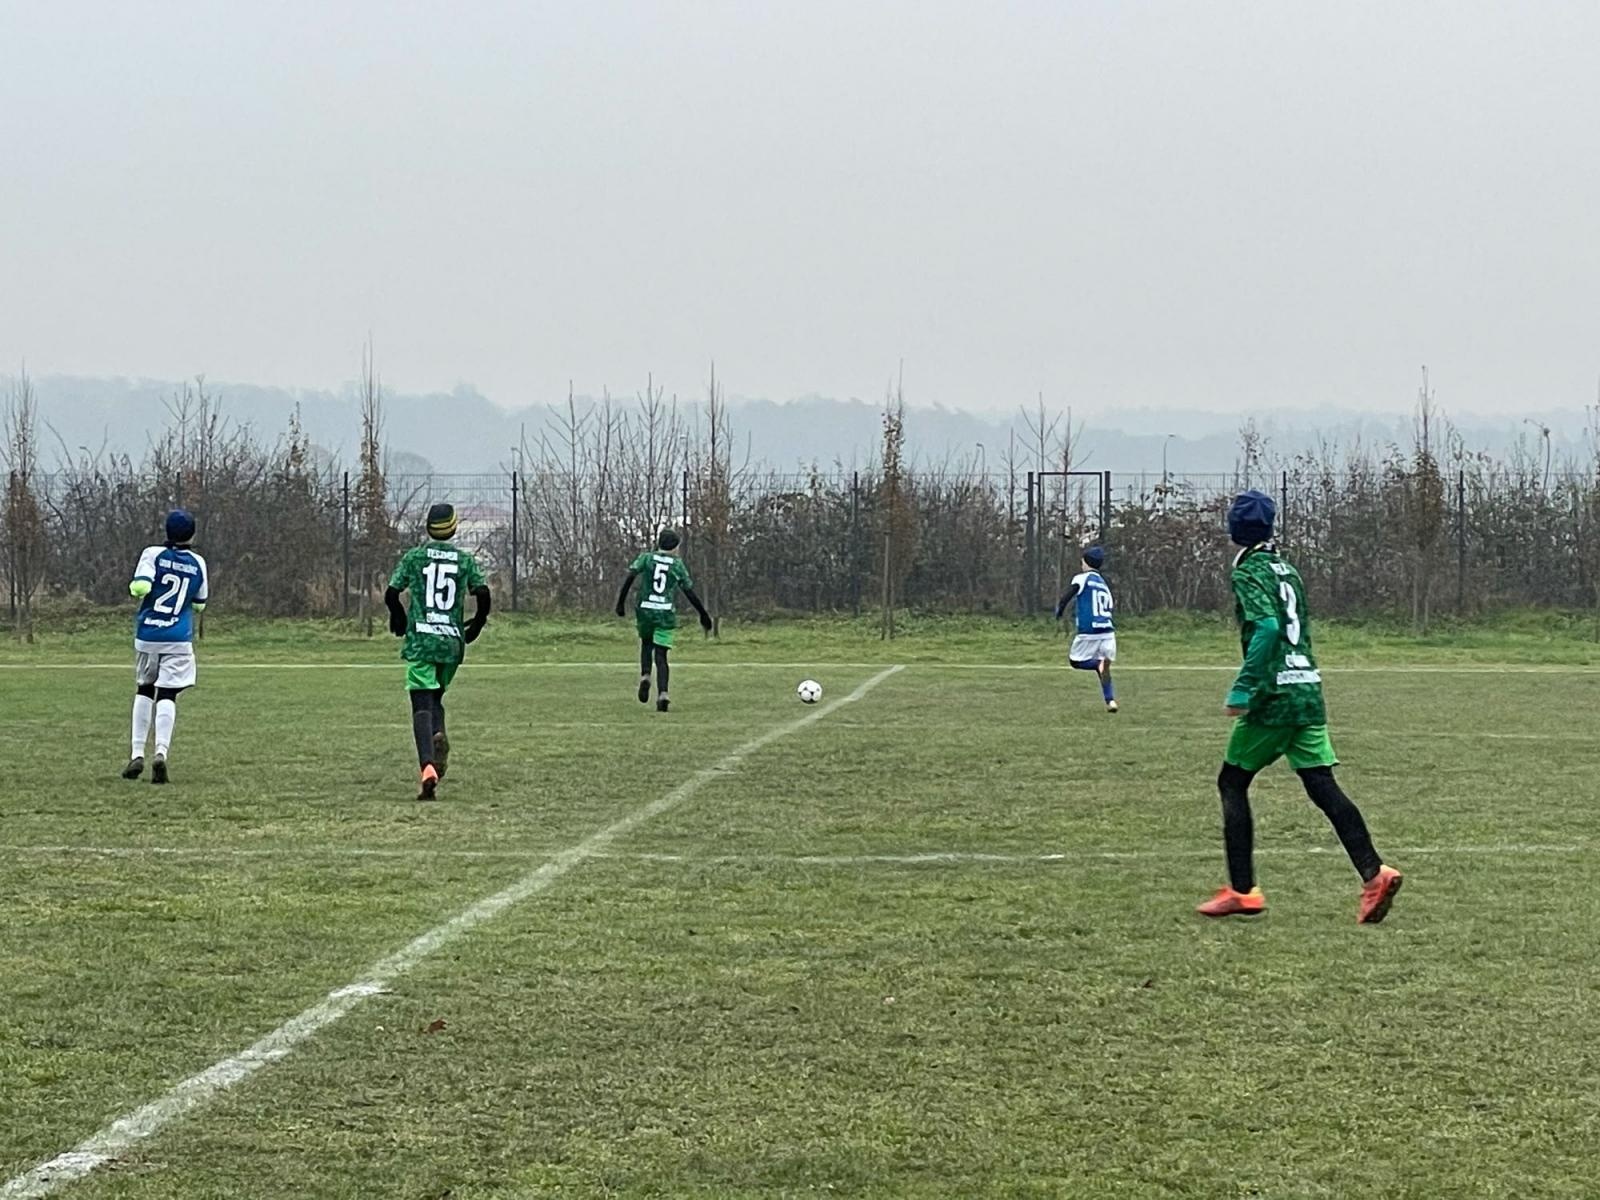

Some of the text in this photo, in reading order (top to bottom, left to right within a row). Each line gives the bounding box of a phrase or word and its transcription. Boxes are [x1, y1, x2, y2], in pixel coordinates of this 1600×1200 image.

[153, 573, 190, 616] 21
[422, 562, 458, 611] 15
[653, 563, 669, 593] 5
